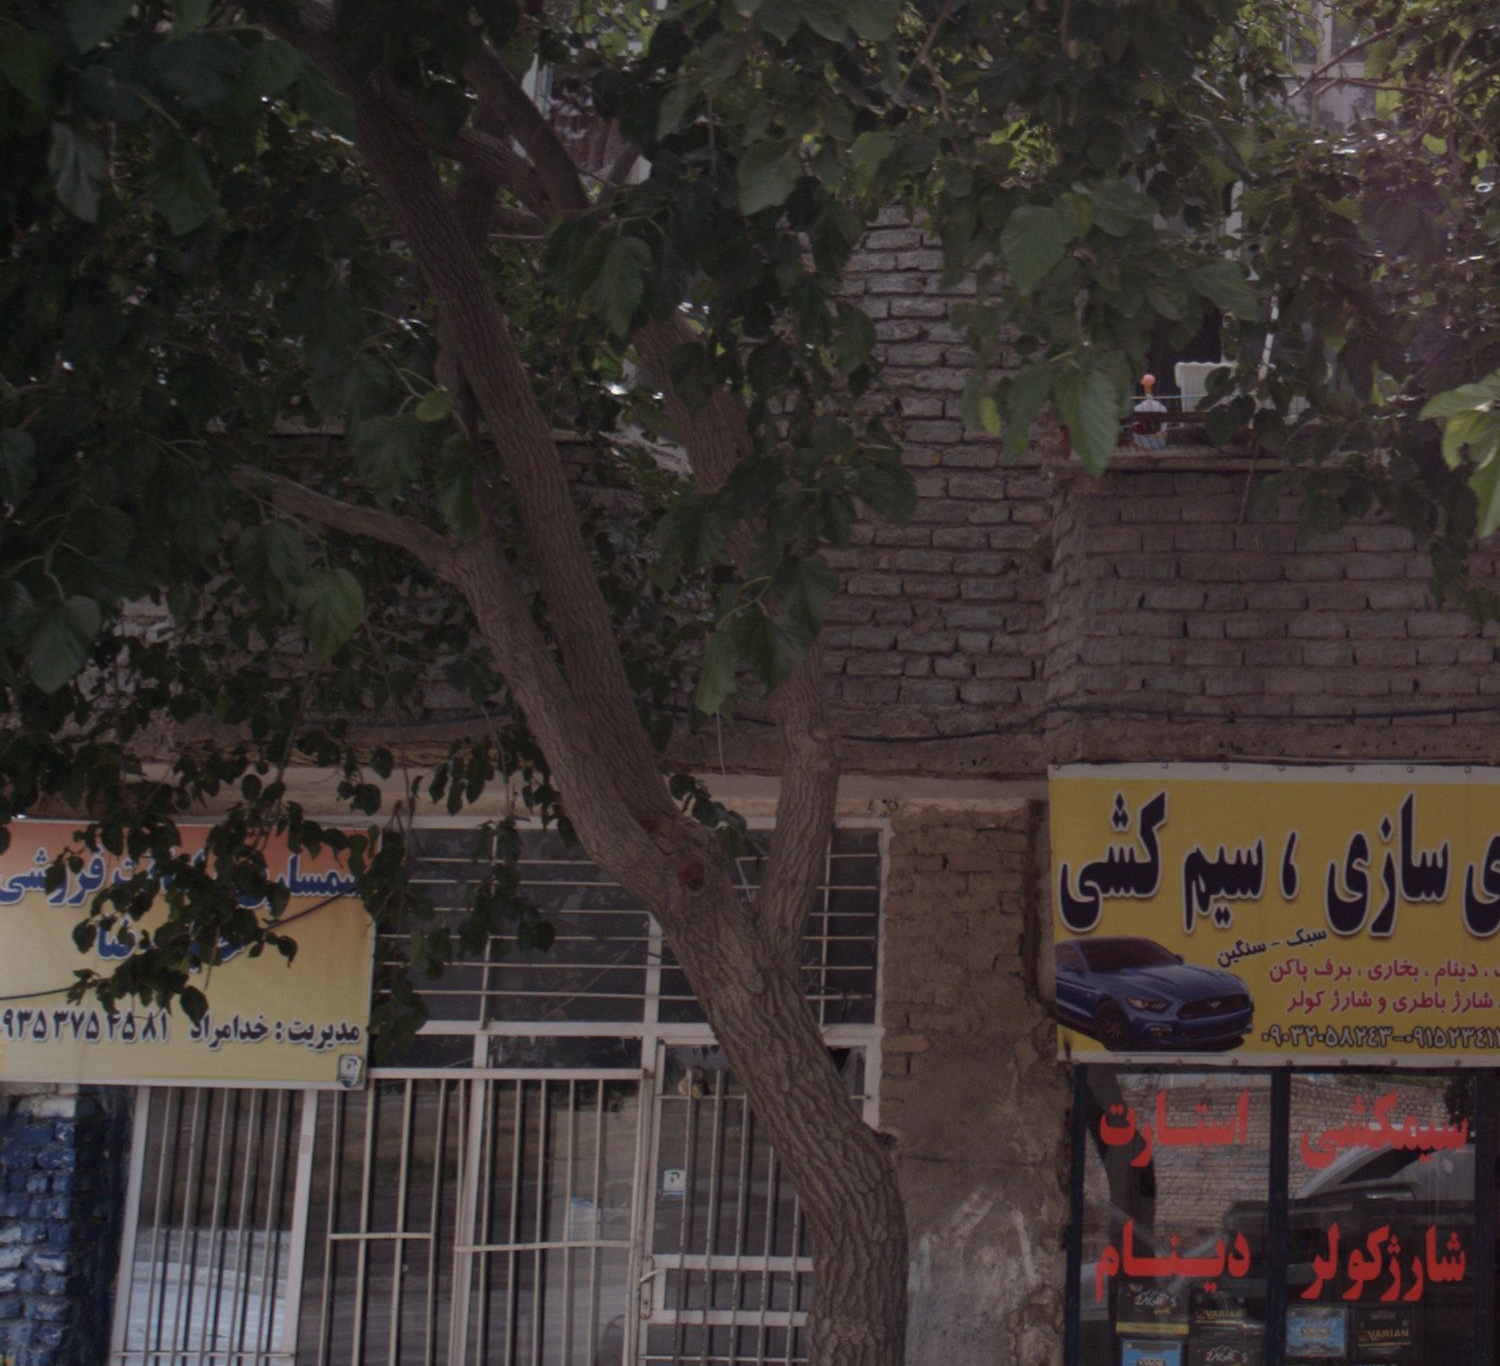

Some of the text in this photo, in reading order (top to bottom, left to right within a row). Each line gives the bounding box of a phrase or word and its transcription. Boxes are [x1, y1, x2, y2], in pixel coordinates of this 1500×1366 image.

[1060, 792, 1167, 931] کشی
[1326, 793, 1448, 936] سازی
[1183, 836, 1264, 931] سیم
[1286, 928, 1327, 948] سبک
[1217, 940, 1267, 968] سنگین
[1269, 958, 1308, 983] پاکن
[1314, 958, 1352, 981] برف
[1368, 959, 1419, 982] بخاری
[1434, 960, 1478, 987] دینام
[1287, 989, 1325, 1014] کولر
[1330, 989, 1372, 1012] شارژ
[1378, 996, 1387, 1014] و
[1393, 991, 1446, 1014] باطری
[1451, 990, 1493, 1013] شارژ
[288, 1021, 360, 1049] مدیریت
[1099, 1088, 1250, 1168] استارت
[1095, 1217, 1252, 1303] دینام
[1367, 1329, 1410, 1341] VARIAN
